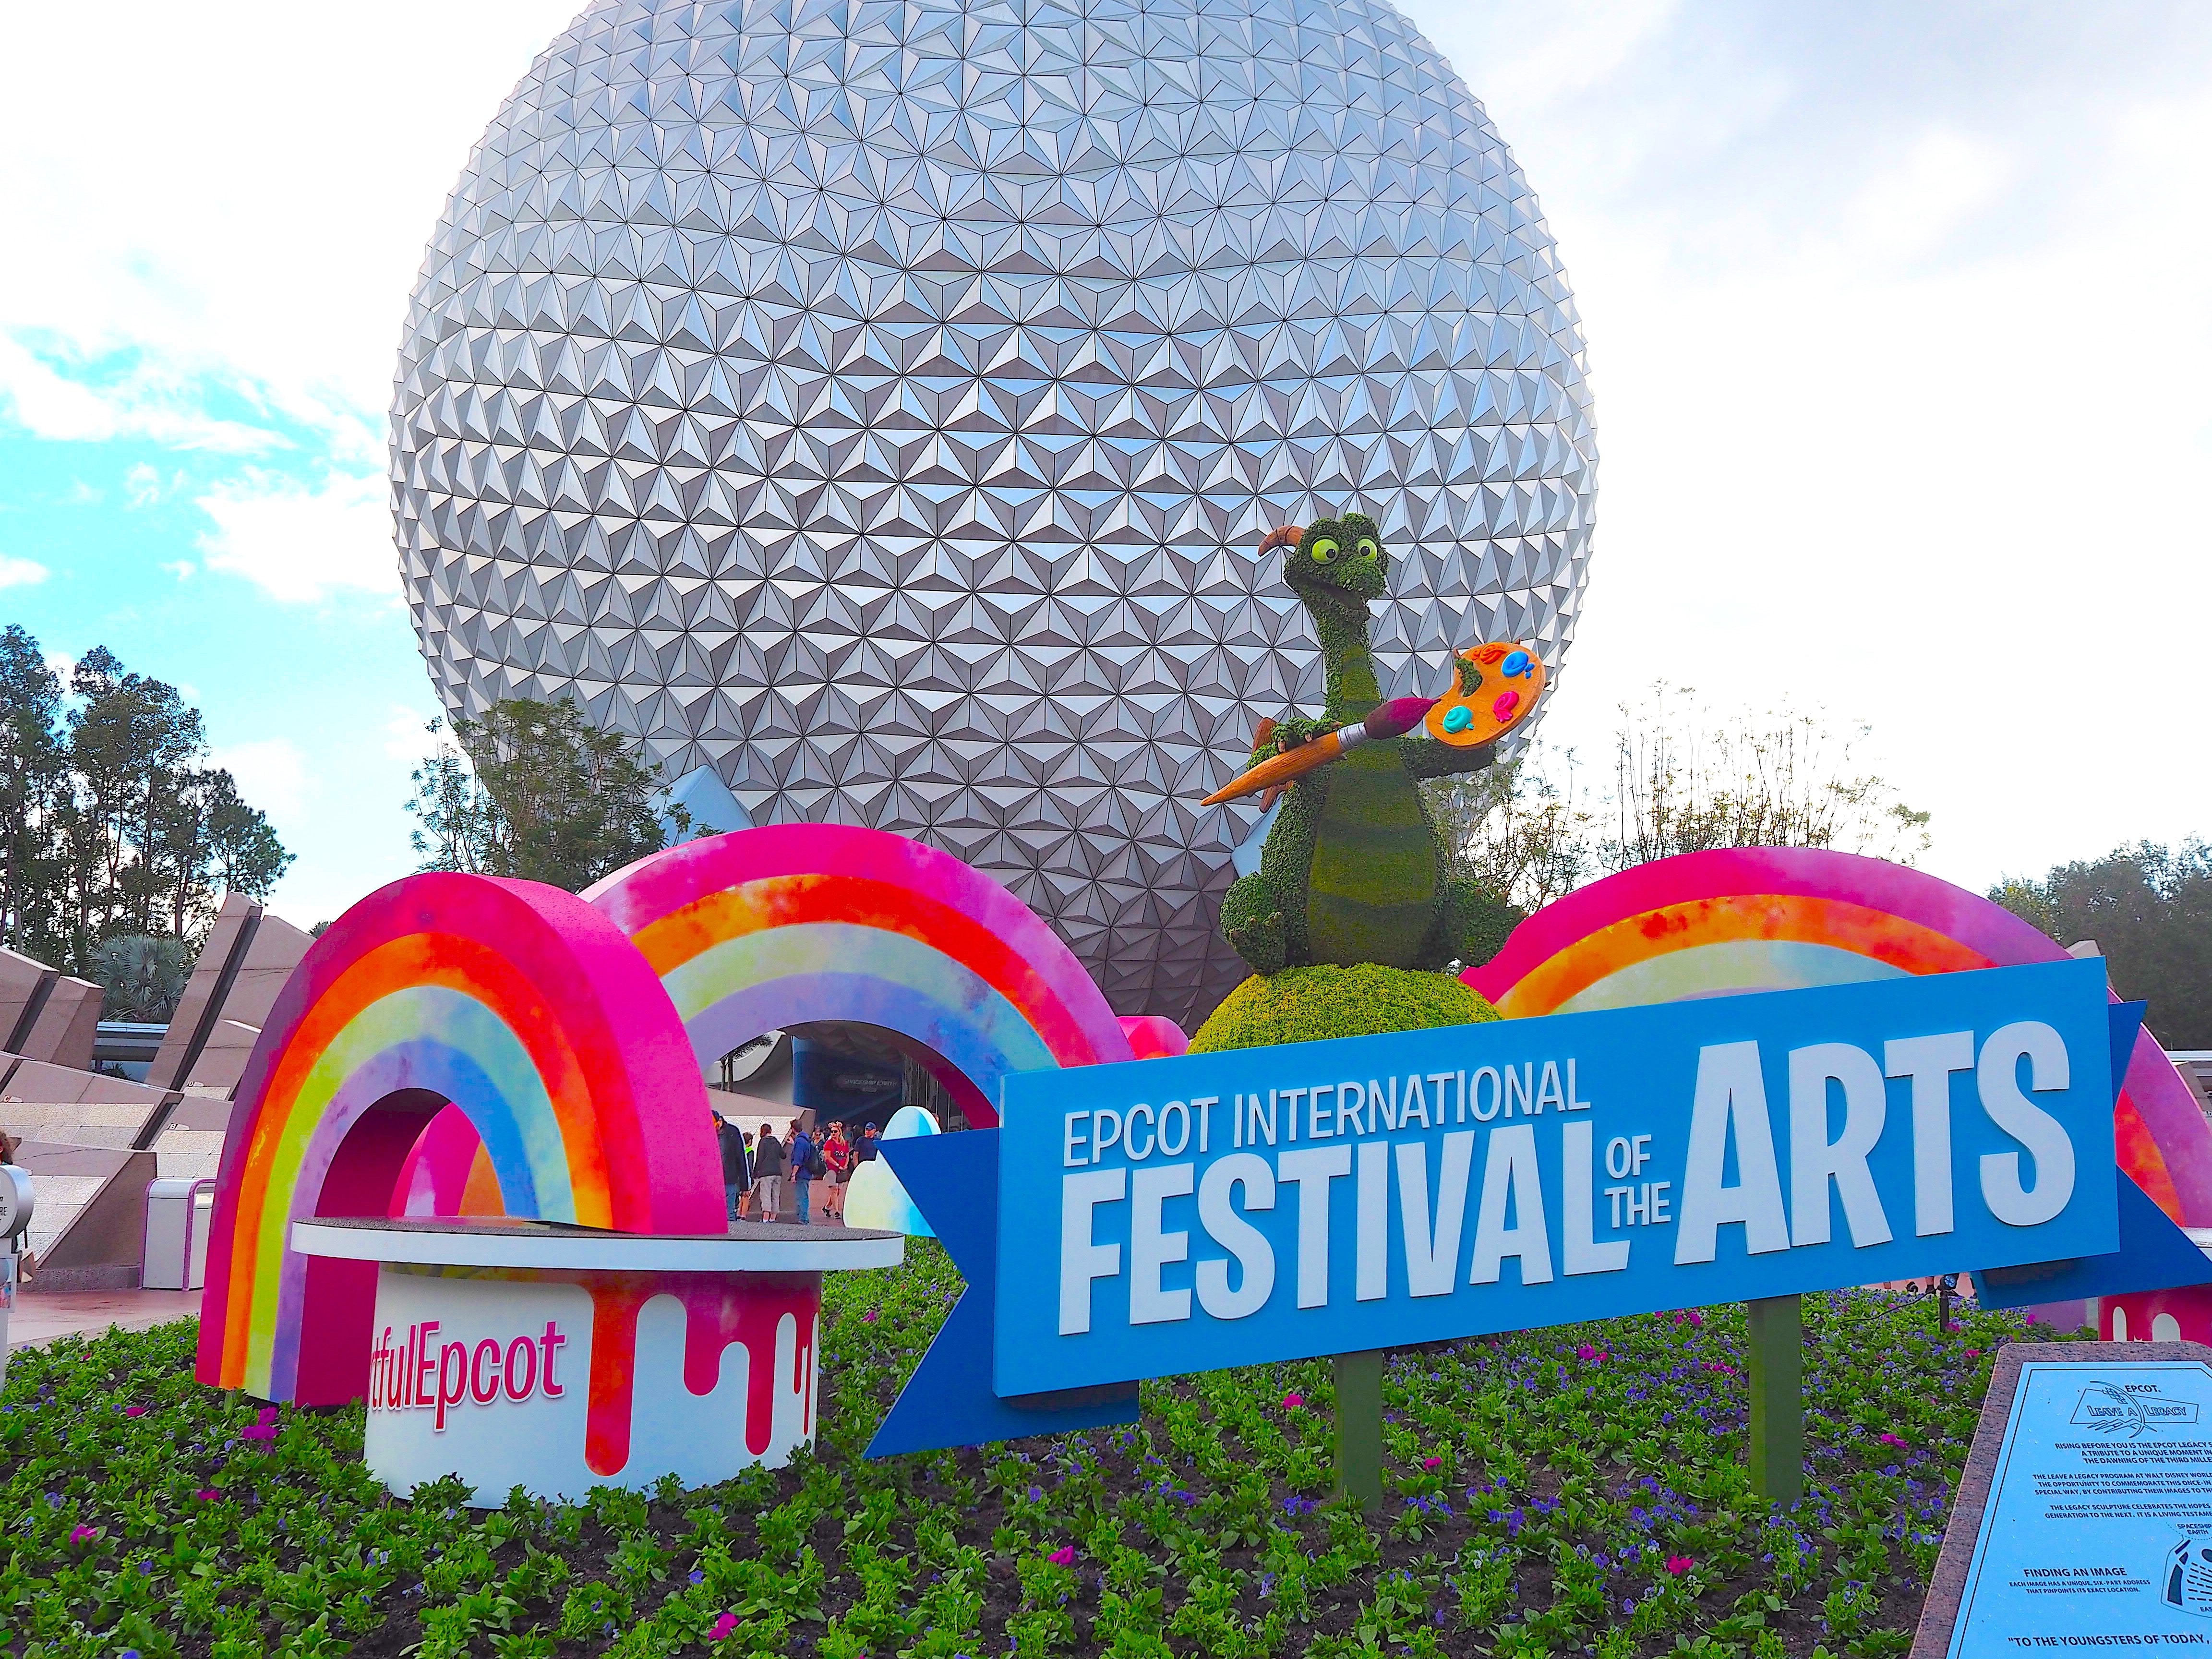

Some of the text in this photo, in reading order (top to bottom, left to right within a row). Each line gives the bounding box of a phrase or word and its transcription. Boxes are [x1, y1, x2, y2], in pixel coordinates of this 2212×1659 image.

[1063, 1058, 1591, 1167] EPCOT INTERNATIONAL
[1059, 1021, 2075, 1335] FESTIVAL OF THE ARTS
[371, 1320, 566, 1431] tfulEpcot
[2087, 1405, 2187, 1416] LEAVE A LEGACY
[2023, 1568, 2128, 1577] FINDING AN IMAGE
[2033, 1637, 2059, 1646] THE
[2059, 1635, 2141, 1646] YOUNGSTERS
[2144, 1635, 2160, 1644] OF
[2161, 1634, 2209, 1645] TODAY,
